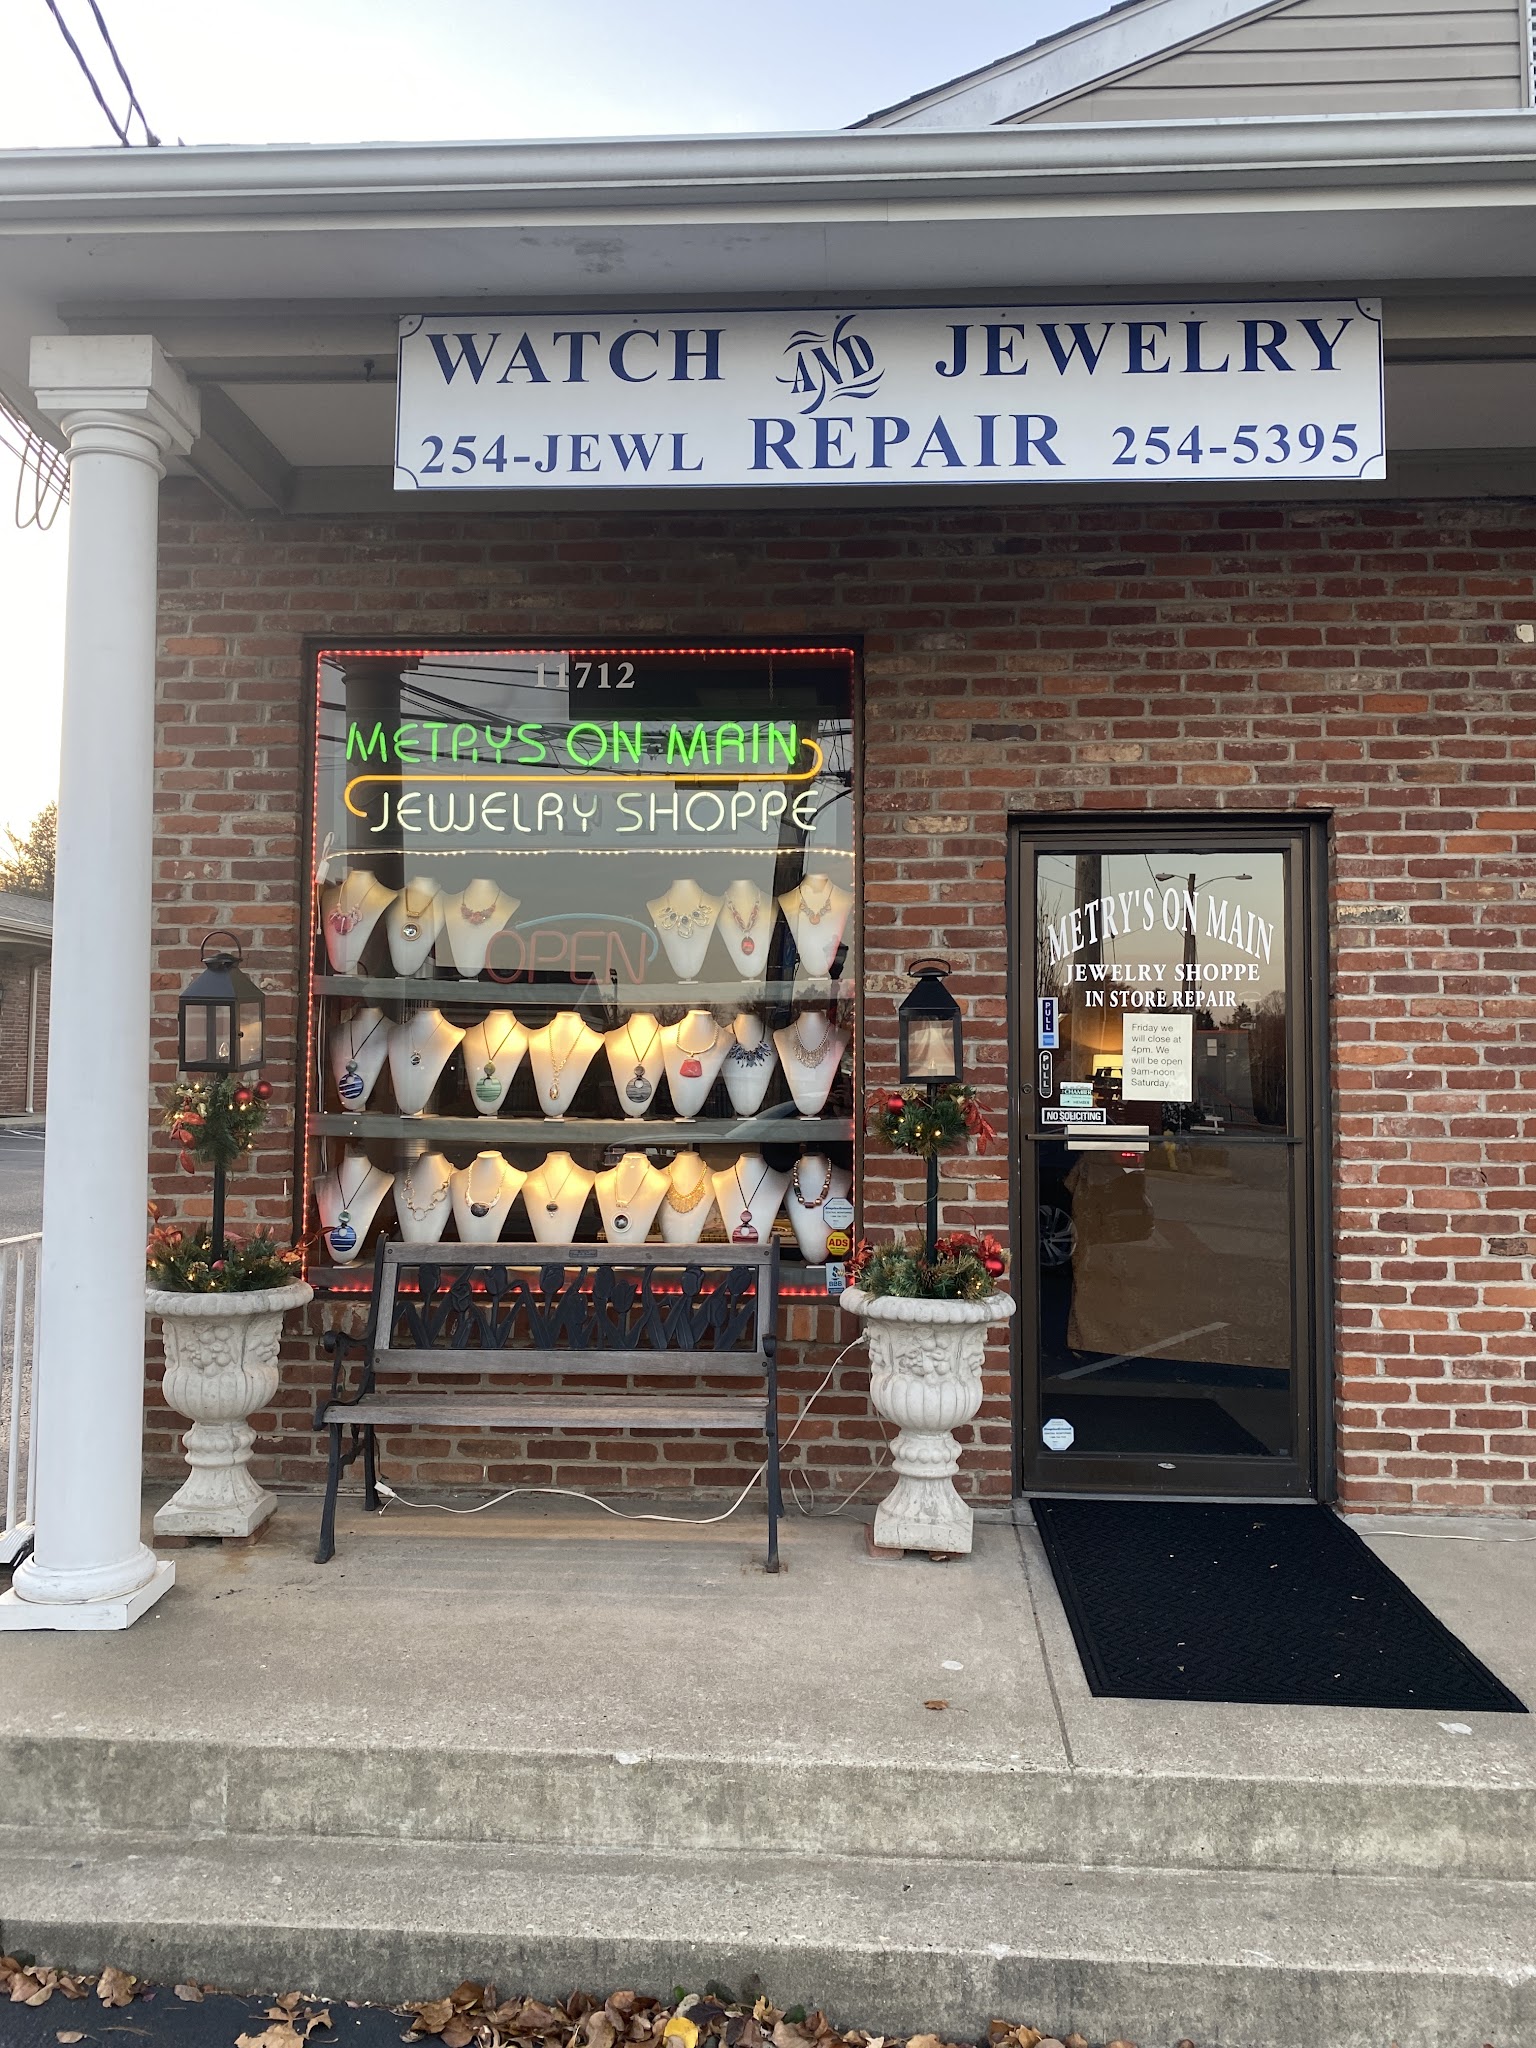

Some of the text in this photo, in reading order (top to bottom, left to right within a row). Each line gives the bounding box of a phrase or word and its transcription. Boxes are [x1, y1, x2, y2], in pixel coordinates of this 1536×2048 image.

[425, 314, 1355, 415] WATCH AND JEWELRY
[419, 413, 1359, 474] 254-JEWL REPAIR 254-5395
[534, 661, 636, 690] 11712
[345, 721, 797, 767] METRYS ON MAIN
[370, 790, 819, 834] JEWELRY SHOPPE
[1047, 887, 1275, 967] METRY'S ON MAIN
[484, 928, 648, 985] OPEN
[1063, 963, 1260, 987] JEWELRY SHOPPE
[1085, 990, 1238, 1008] IN STORE REPAIR
[1131, 1023, 1159, 1033] Friday
[1147, 1035, 1171, 1043] close
[1173, 1036, 1182, 1044] at
[1131, 1045, 1170, 1054] 4pm. We
[1147, 1057, 1159, 1065] be
[1160, 1058, 1183, 1066] open
[1042, 1054, 1050, 1088] PULL
[1130, 1067, 1175, 1076] 9am-noon
[1046, 1111, 1102, 1121] NO SOLICITING
[828, 1238, 849, 1247] ADS
